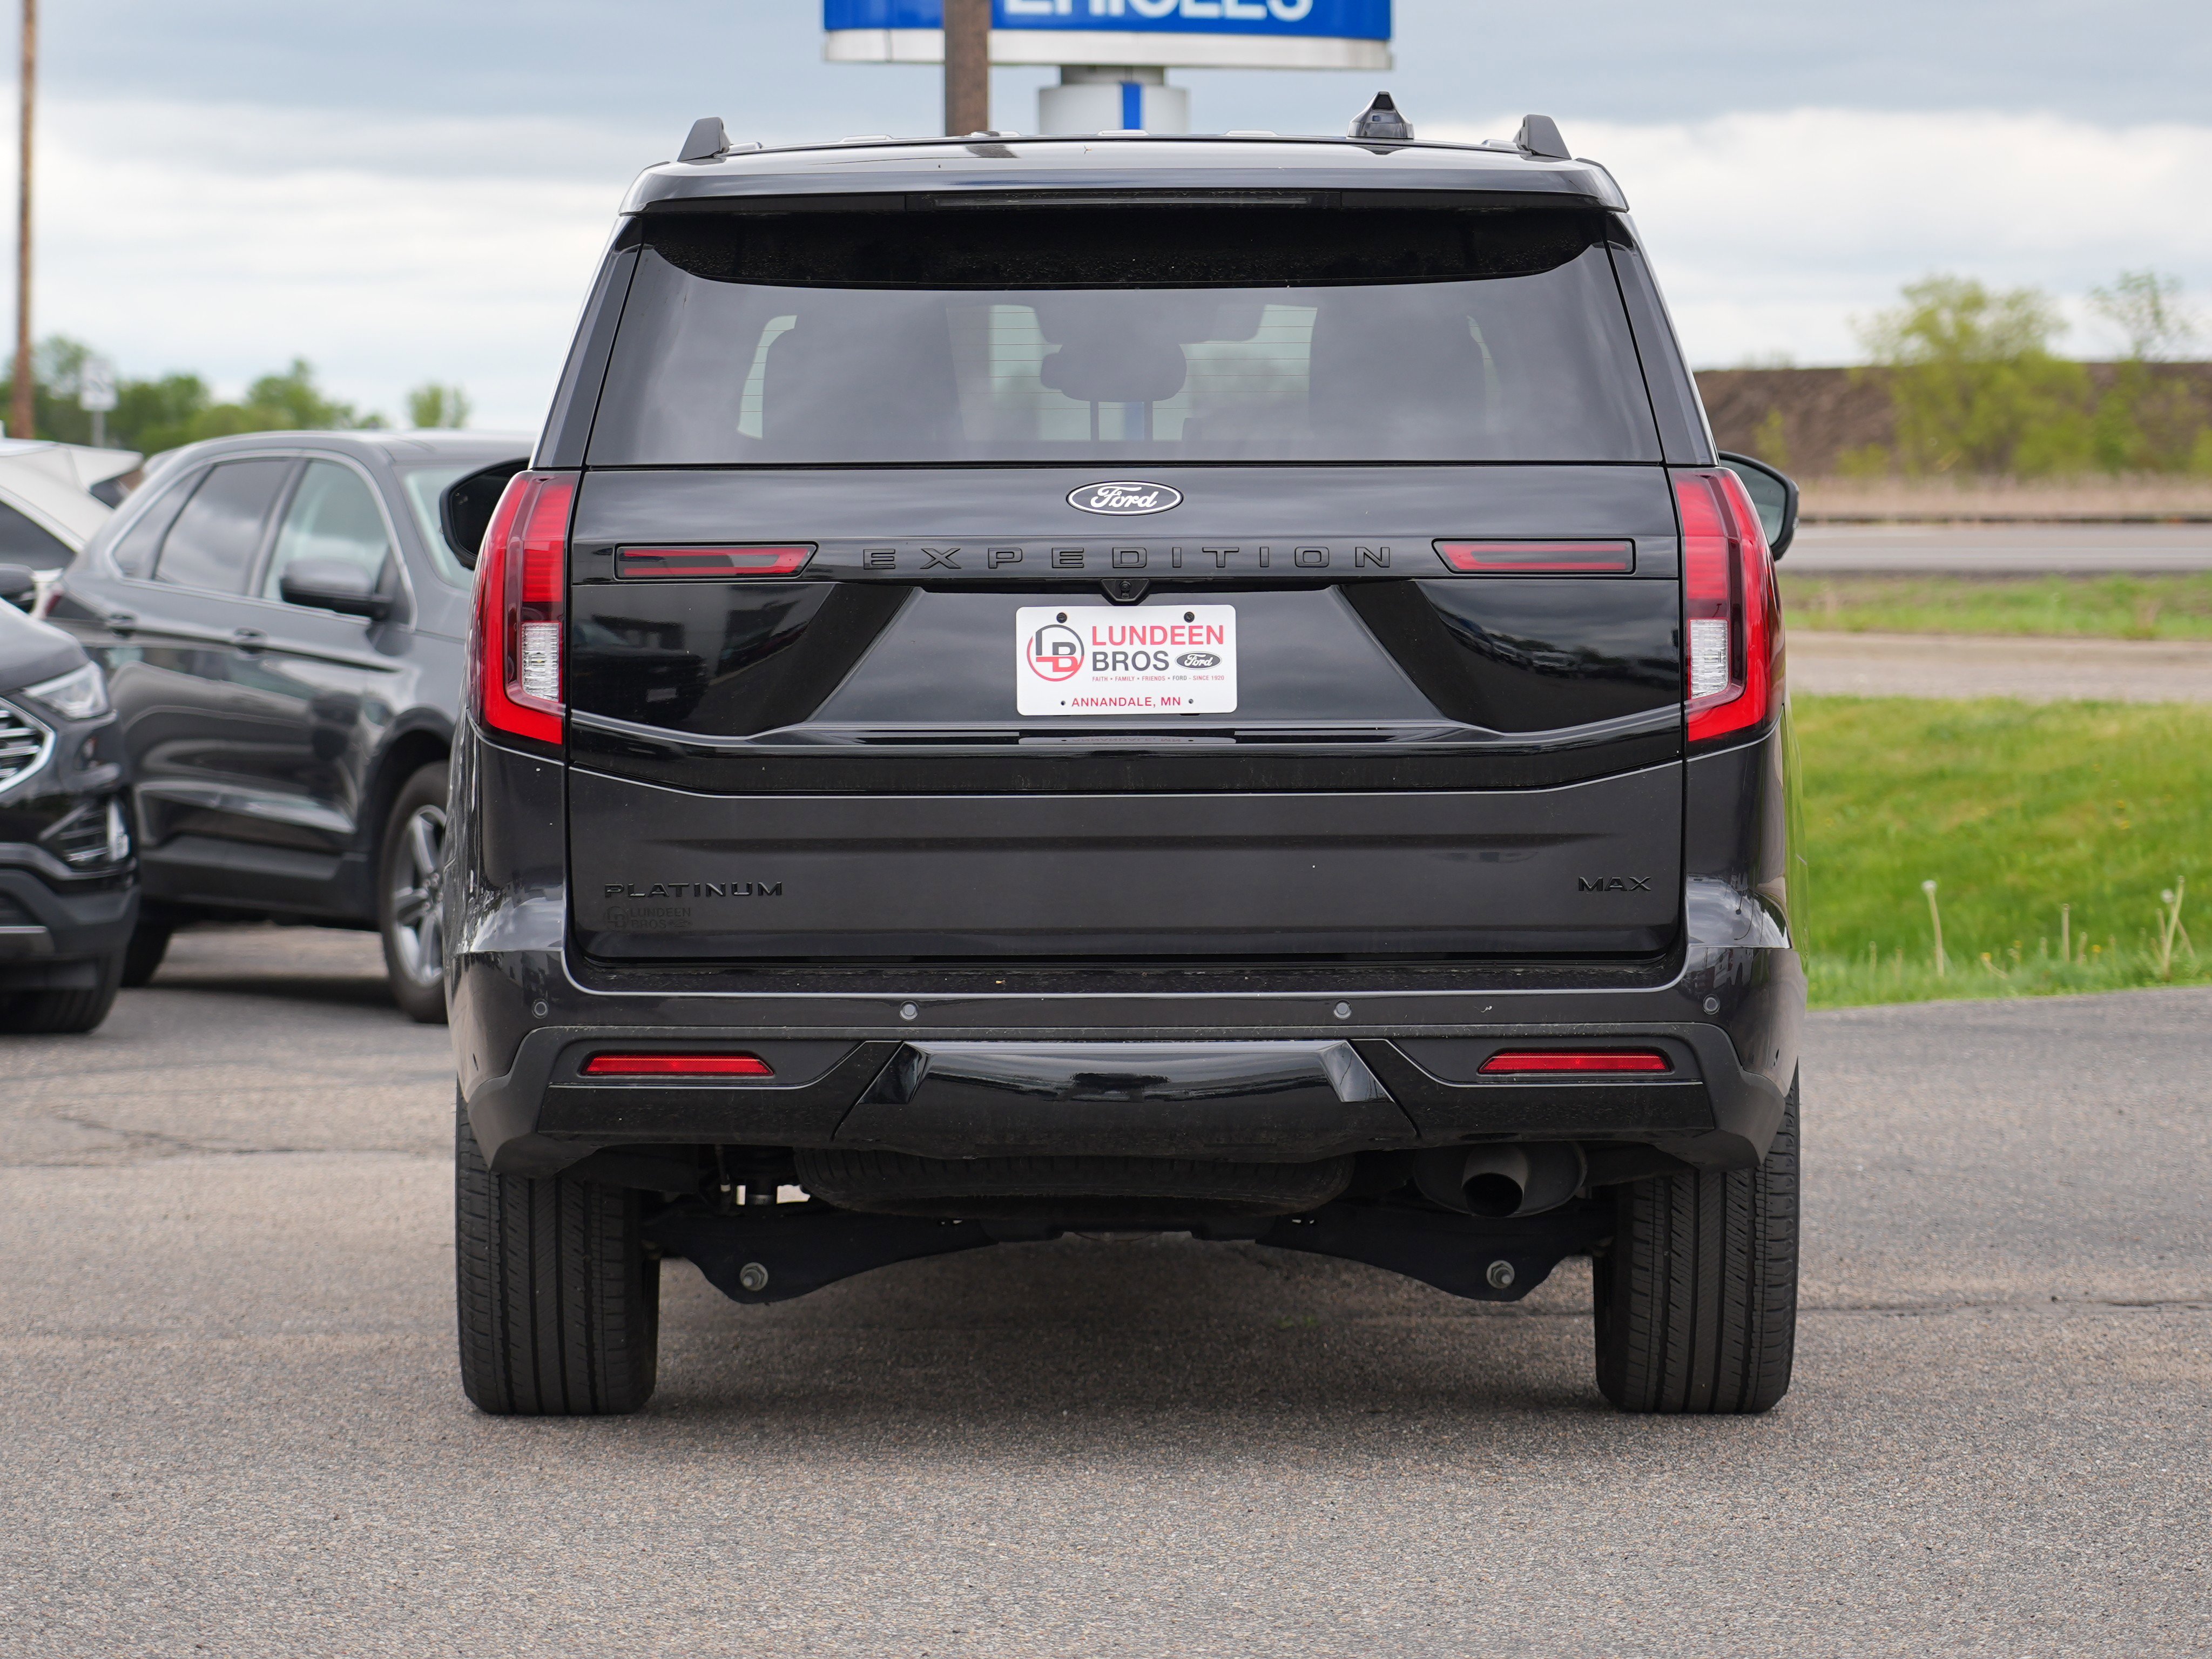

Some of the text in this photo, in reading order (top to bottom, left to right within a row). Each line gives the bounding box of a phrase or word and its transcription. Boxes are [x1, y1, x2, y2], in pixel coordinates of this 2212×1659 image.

[1090, 487, 1159, 507] Ford
[863, 546, 1391, 570] EXPEDITION
[1092, 625, 1224, 646] LUNDEEN
[1092, 651, 1169, 671] BROS
[1184, 654, 1213, 667] Ford
[1072, 697, 1181, 707] ANNANDALE, MN
[604, 882, 783, 898] PLATINUM
[1578, 876, 1651, 891] MAX
[631, 908, 691, 917] LUNDEEN
